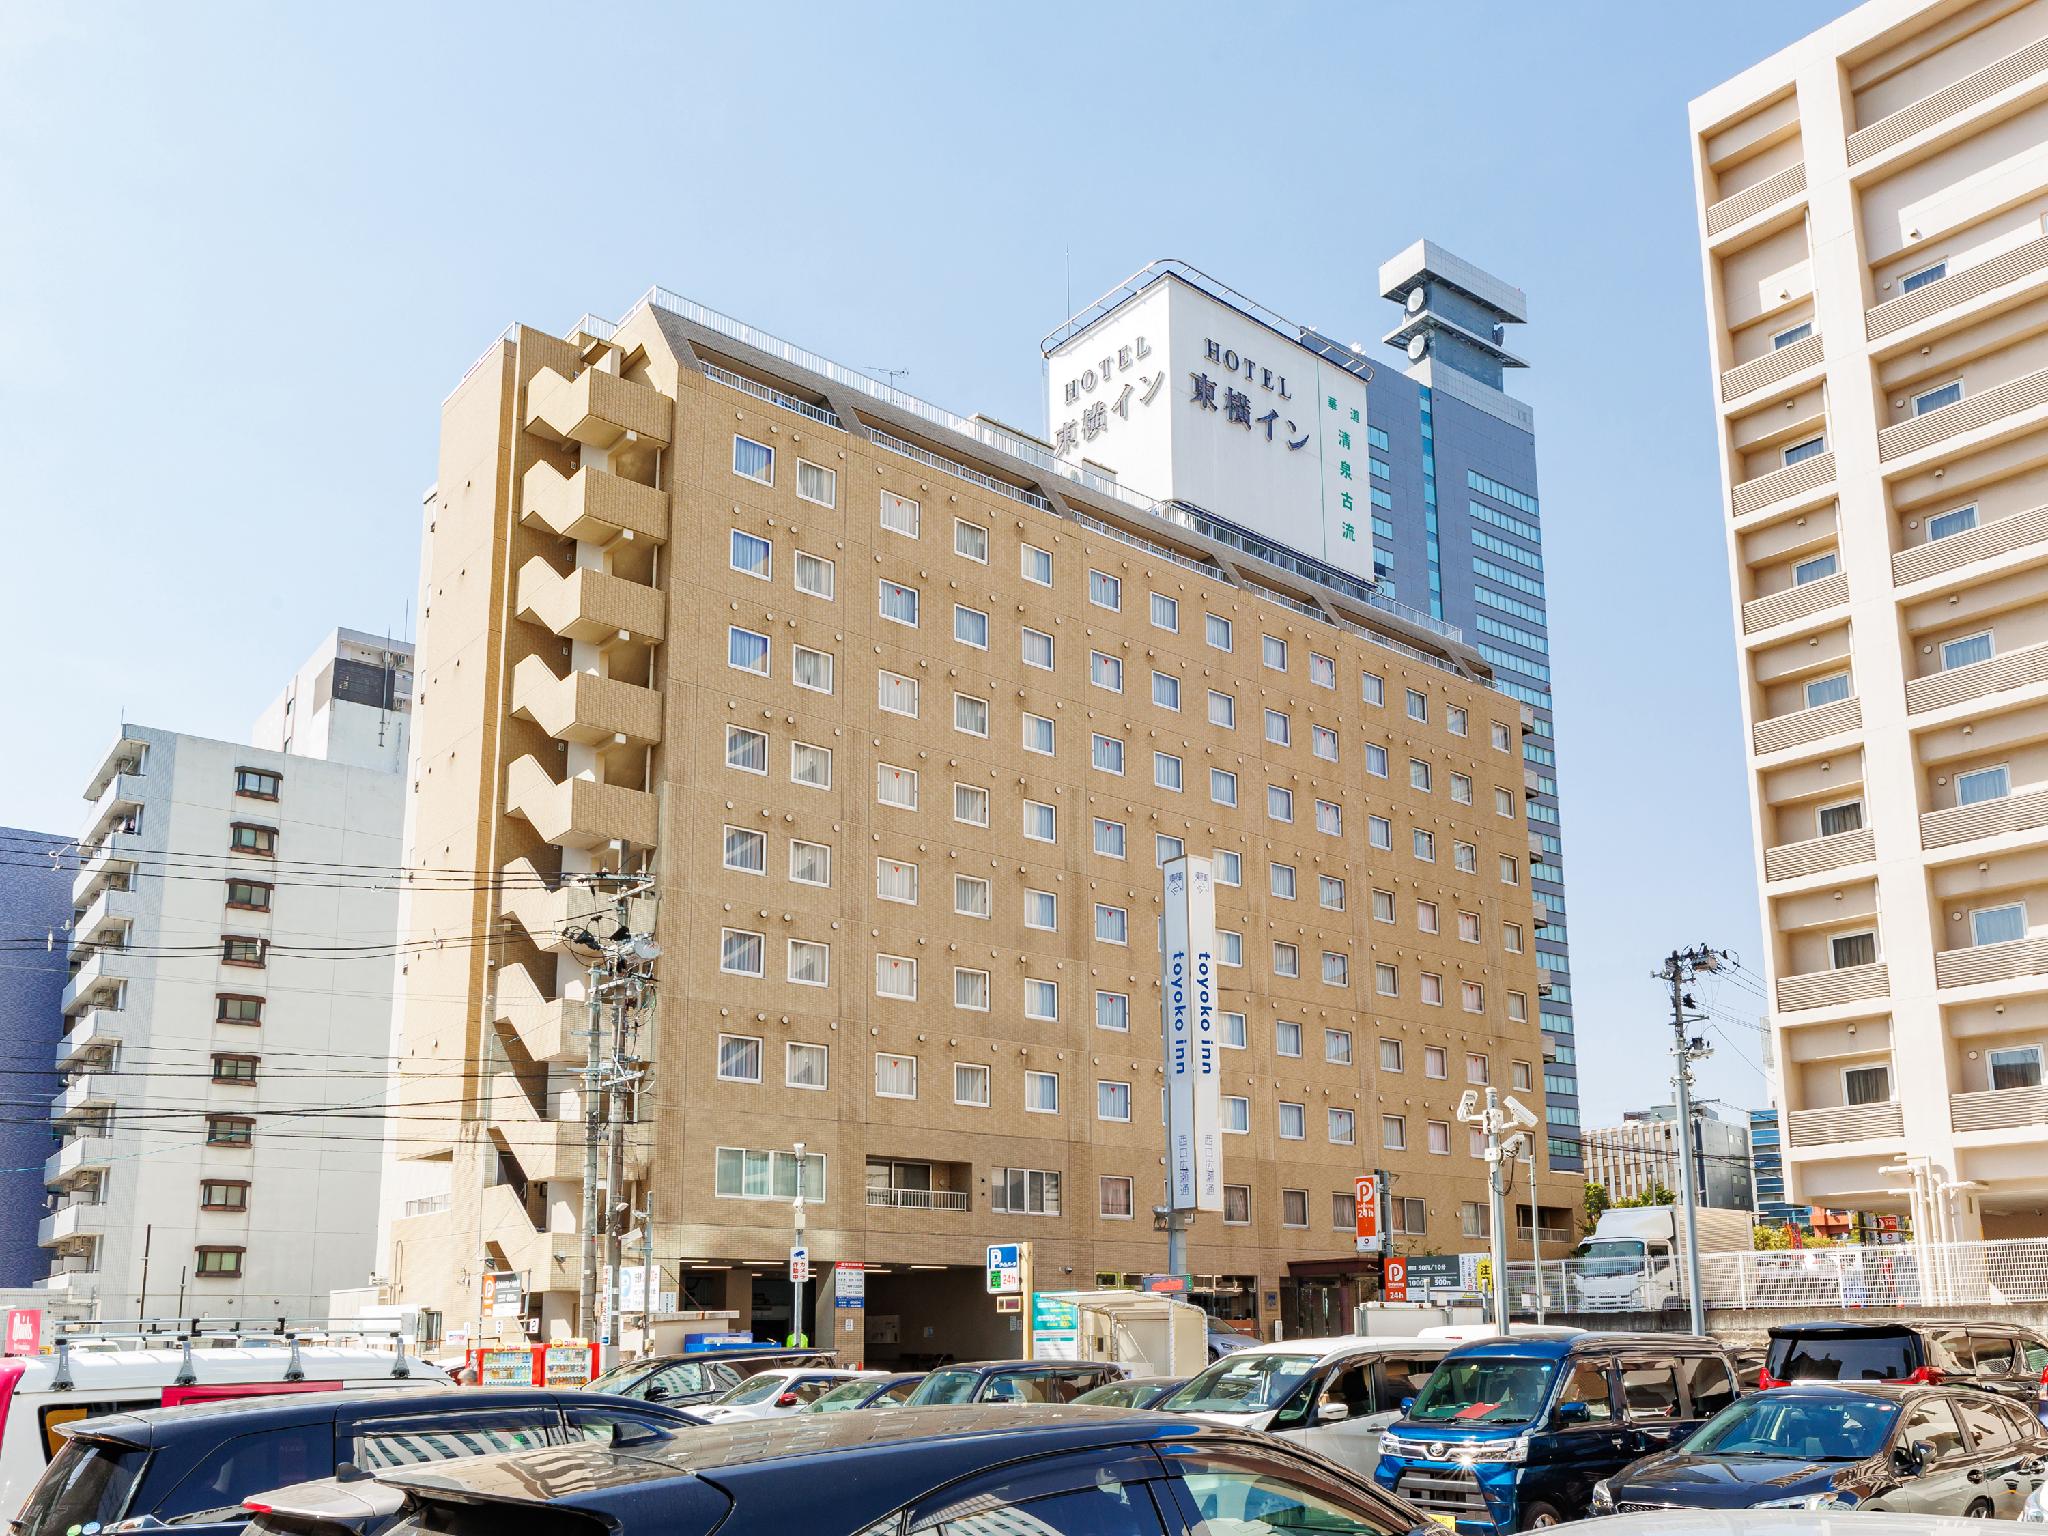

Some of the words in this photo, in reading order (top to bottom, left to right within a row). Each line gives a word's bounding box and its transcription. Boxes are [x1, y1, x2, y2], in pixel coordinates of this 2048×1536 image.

[1065, 336, 1152, 406] HOTEL
[1204, 338, 1292, 401] HOTEL
[1054, 370, 1165, 459] 東横イン
[1188, 371, 1310, 451] 東横イン
[1338, 429, 1356, 542] 清泉古流
[1170, 951, 1187, 1032] toyoko
[1197, 951, 1213, 1032] toyoko
[1175, 1039, 1187, 1075] inn
[1201, 1039, 1214, 1075] inn
[1358, 1209, 1374, 1218] 24h
[990, 1248, 1002, 1271] P
[1002, 1274, 1016, 1285] 24h
[1389, 1291, 1405, 1299] 24h
